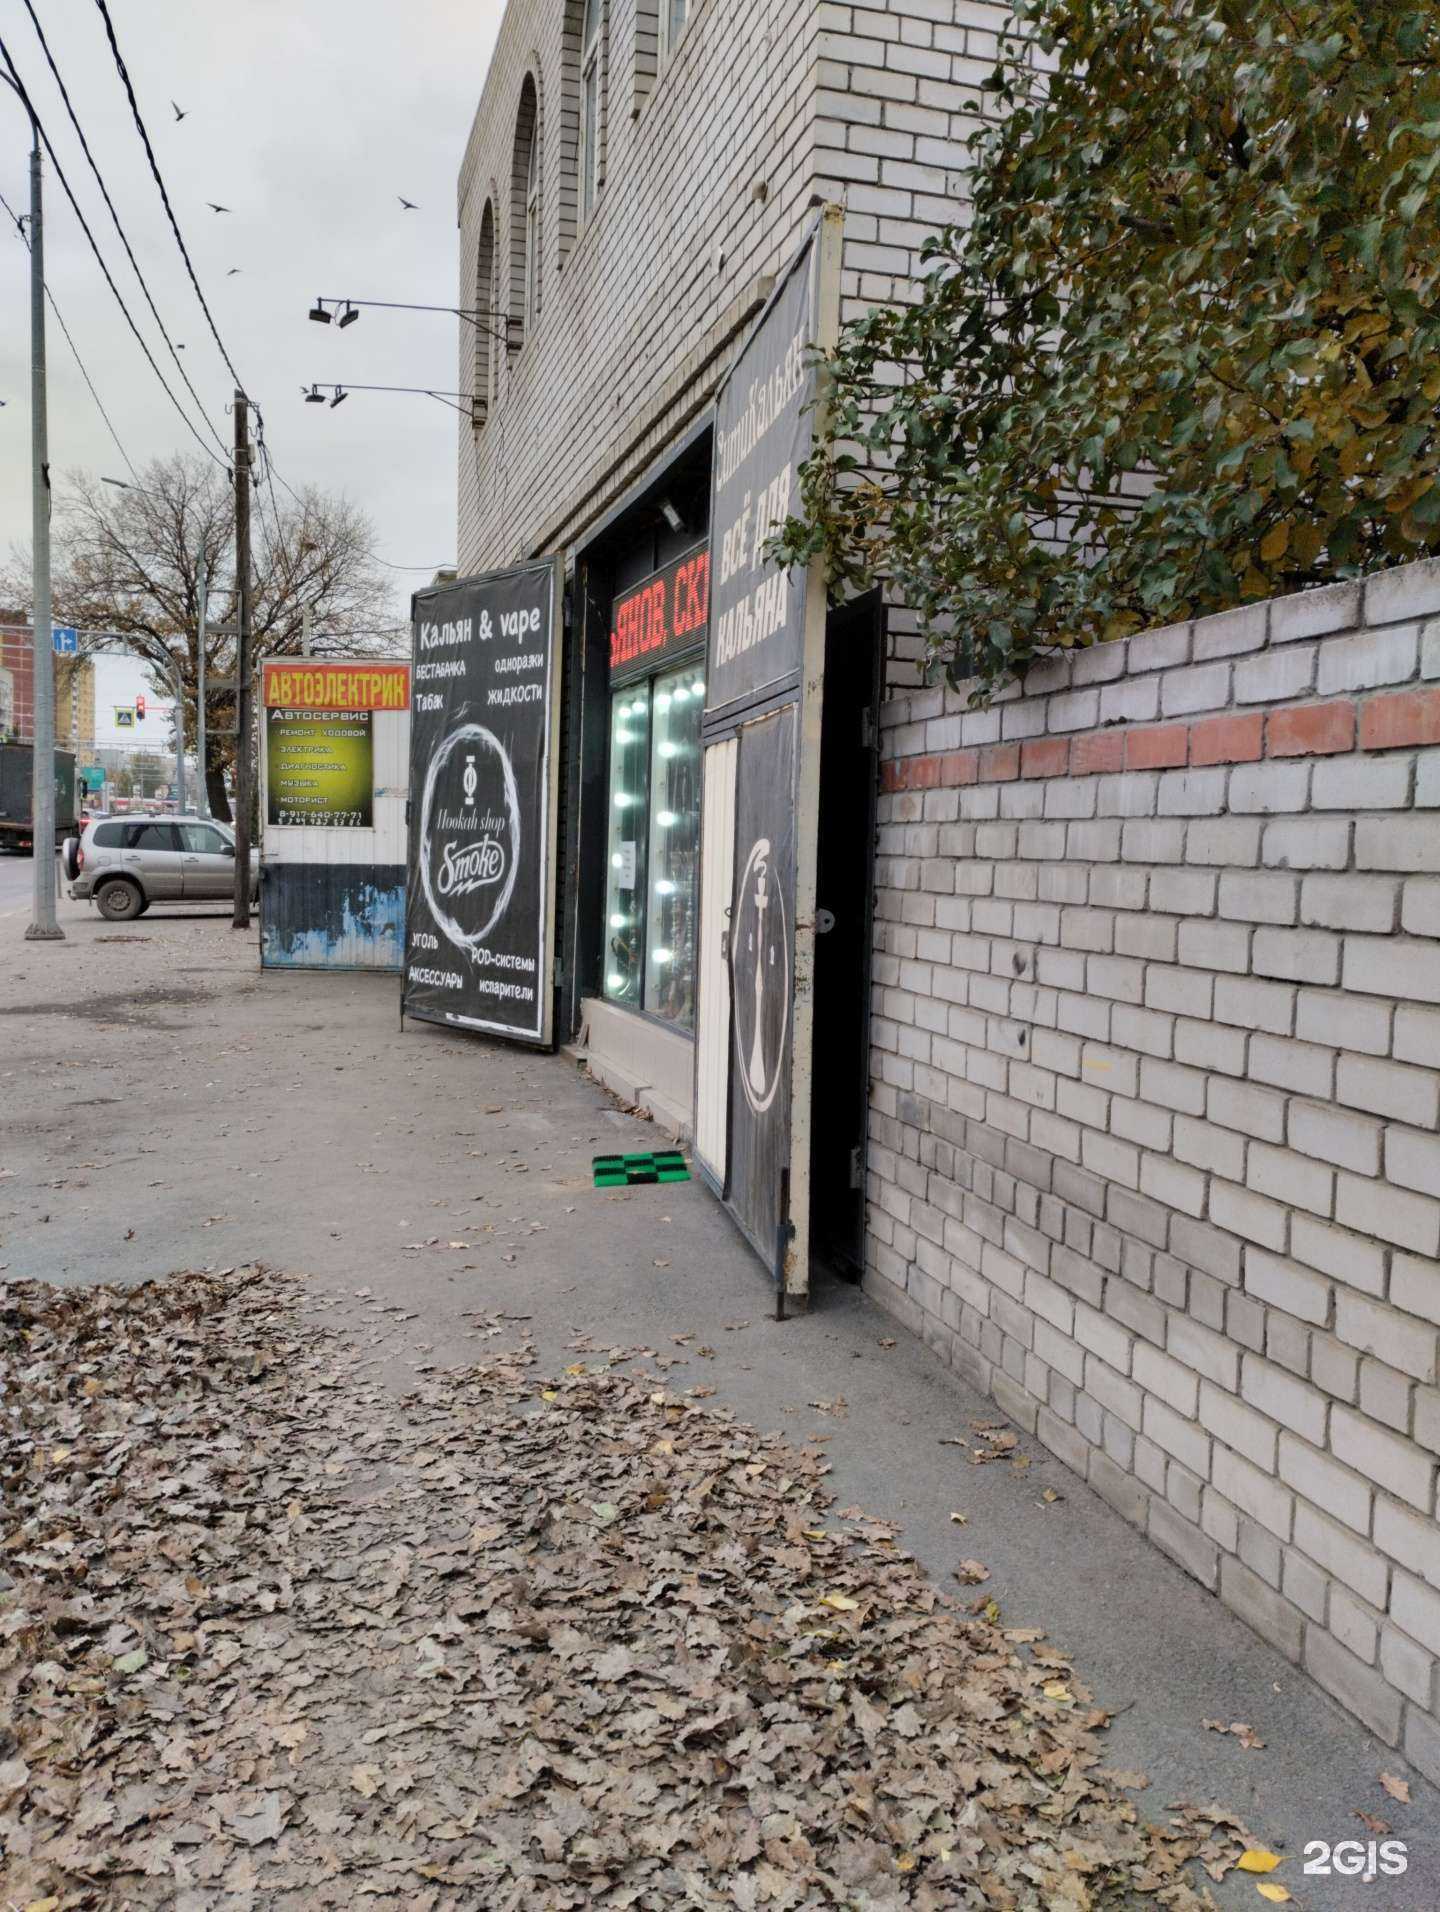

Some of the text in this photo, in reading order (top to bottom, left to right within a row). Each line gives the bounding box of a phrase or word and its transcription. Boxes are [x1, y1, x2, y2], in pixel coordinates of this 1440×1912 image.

[720, 490, 751, 585] ВСЁ
[420, 607, 541, 651] Кальян & vape
[716, 565, 788, 668] КАЛЬЯНА
[416, 693, 444, 712] Табак
[437, 808, 505, 838] Hookah shop
[437, 833, 501, 895] Smoke
